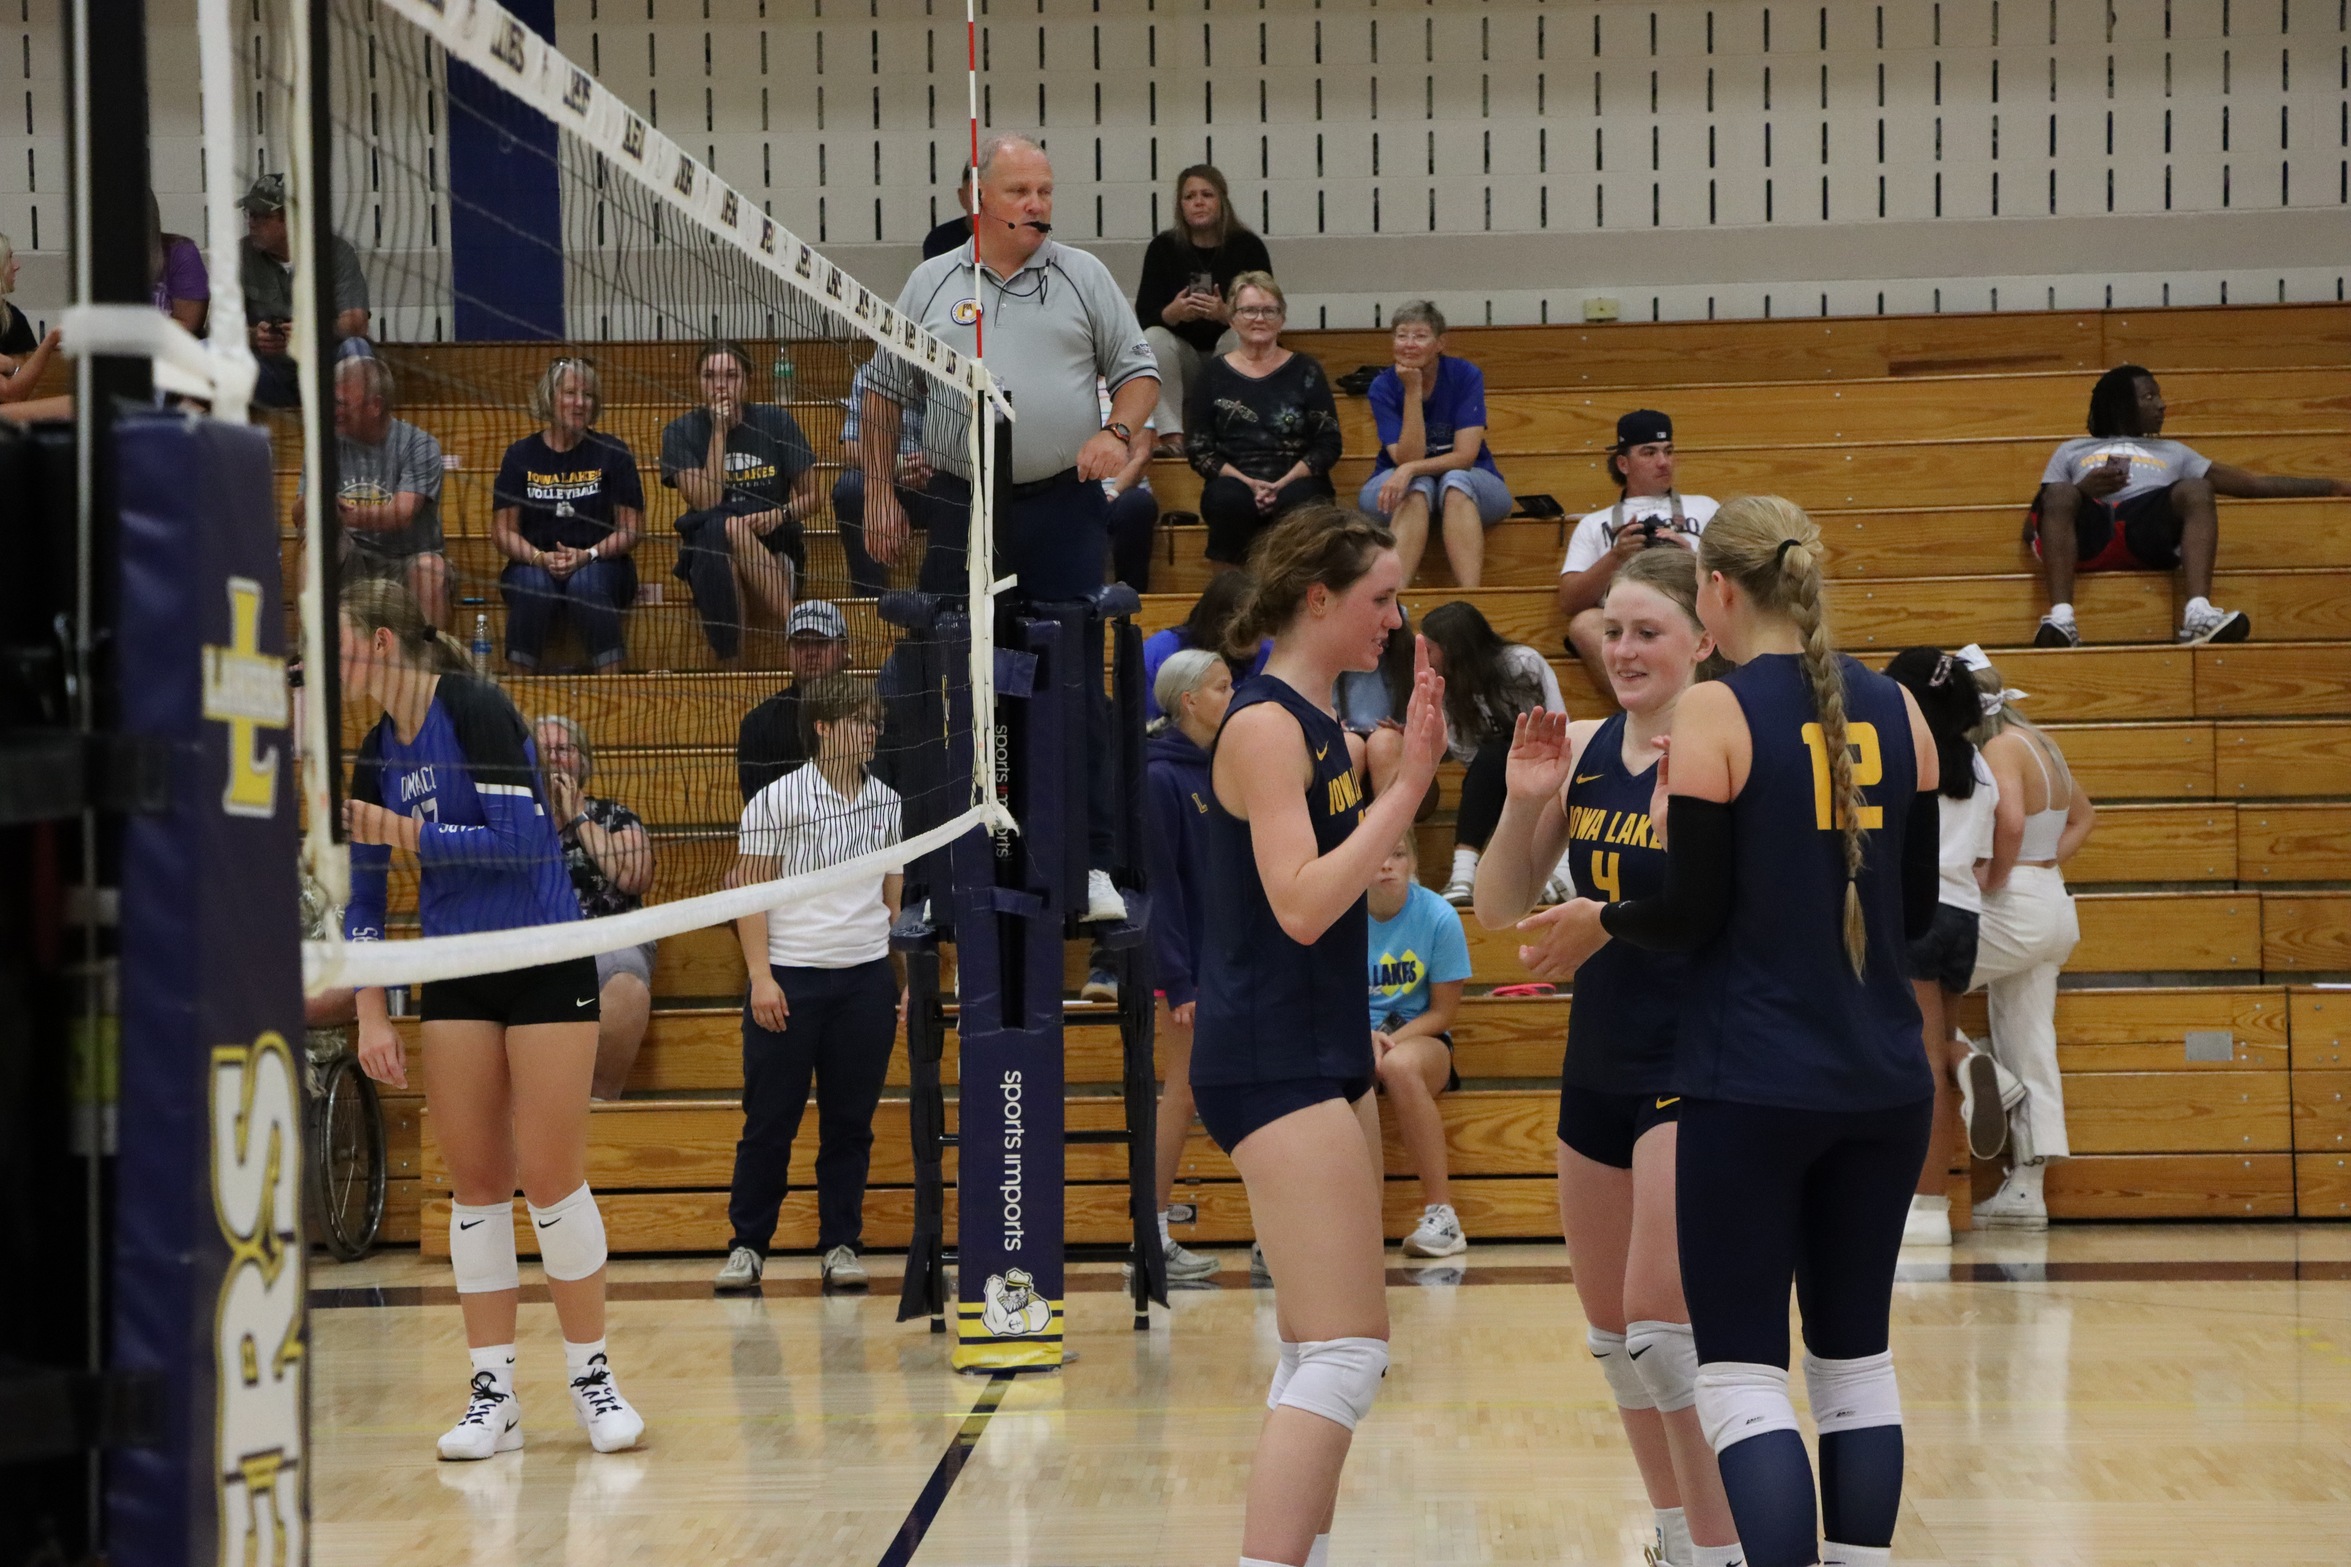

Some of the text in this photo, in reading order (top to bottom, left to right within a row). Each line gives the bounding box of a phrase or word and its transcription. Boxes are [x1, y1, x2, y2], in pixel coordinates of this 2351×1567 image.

[527, 468, 602, 485] IOWA LAKES
[527, 483, 601, 500] VOLLEYBALL
[994, 724, 1011, 783] sports
[1801, 721, 1884, 830] 12
[1591, 850, 1620, 903] 4
[1000, 1071, 1025, 1150] sports
